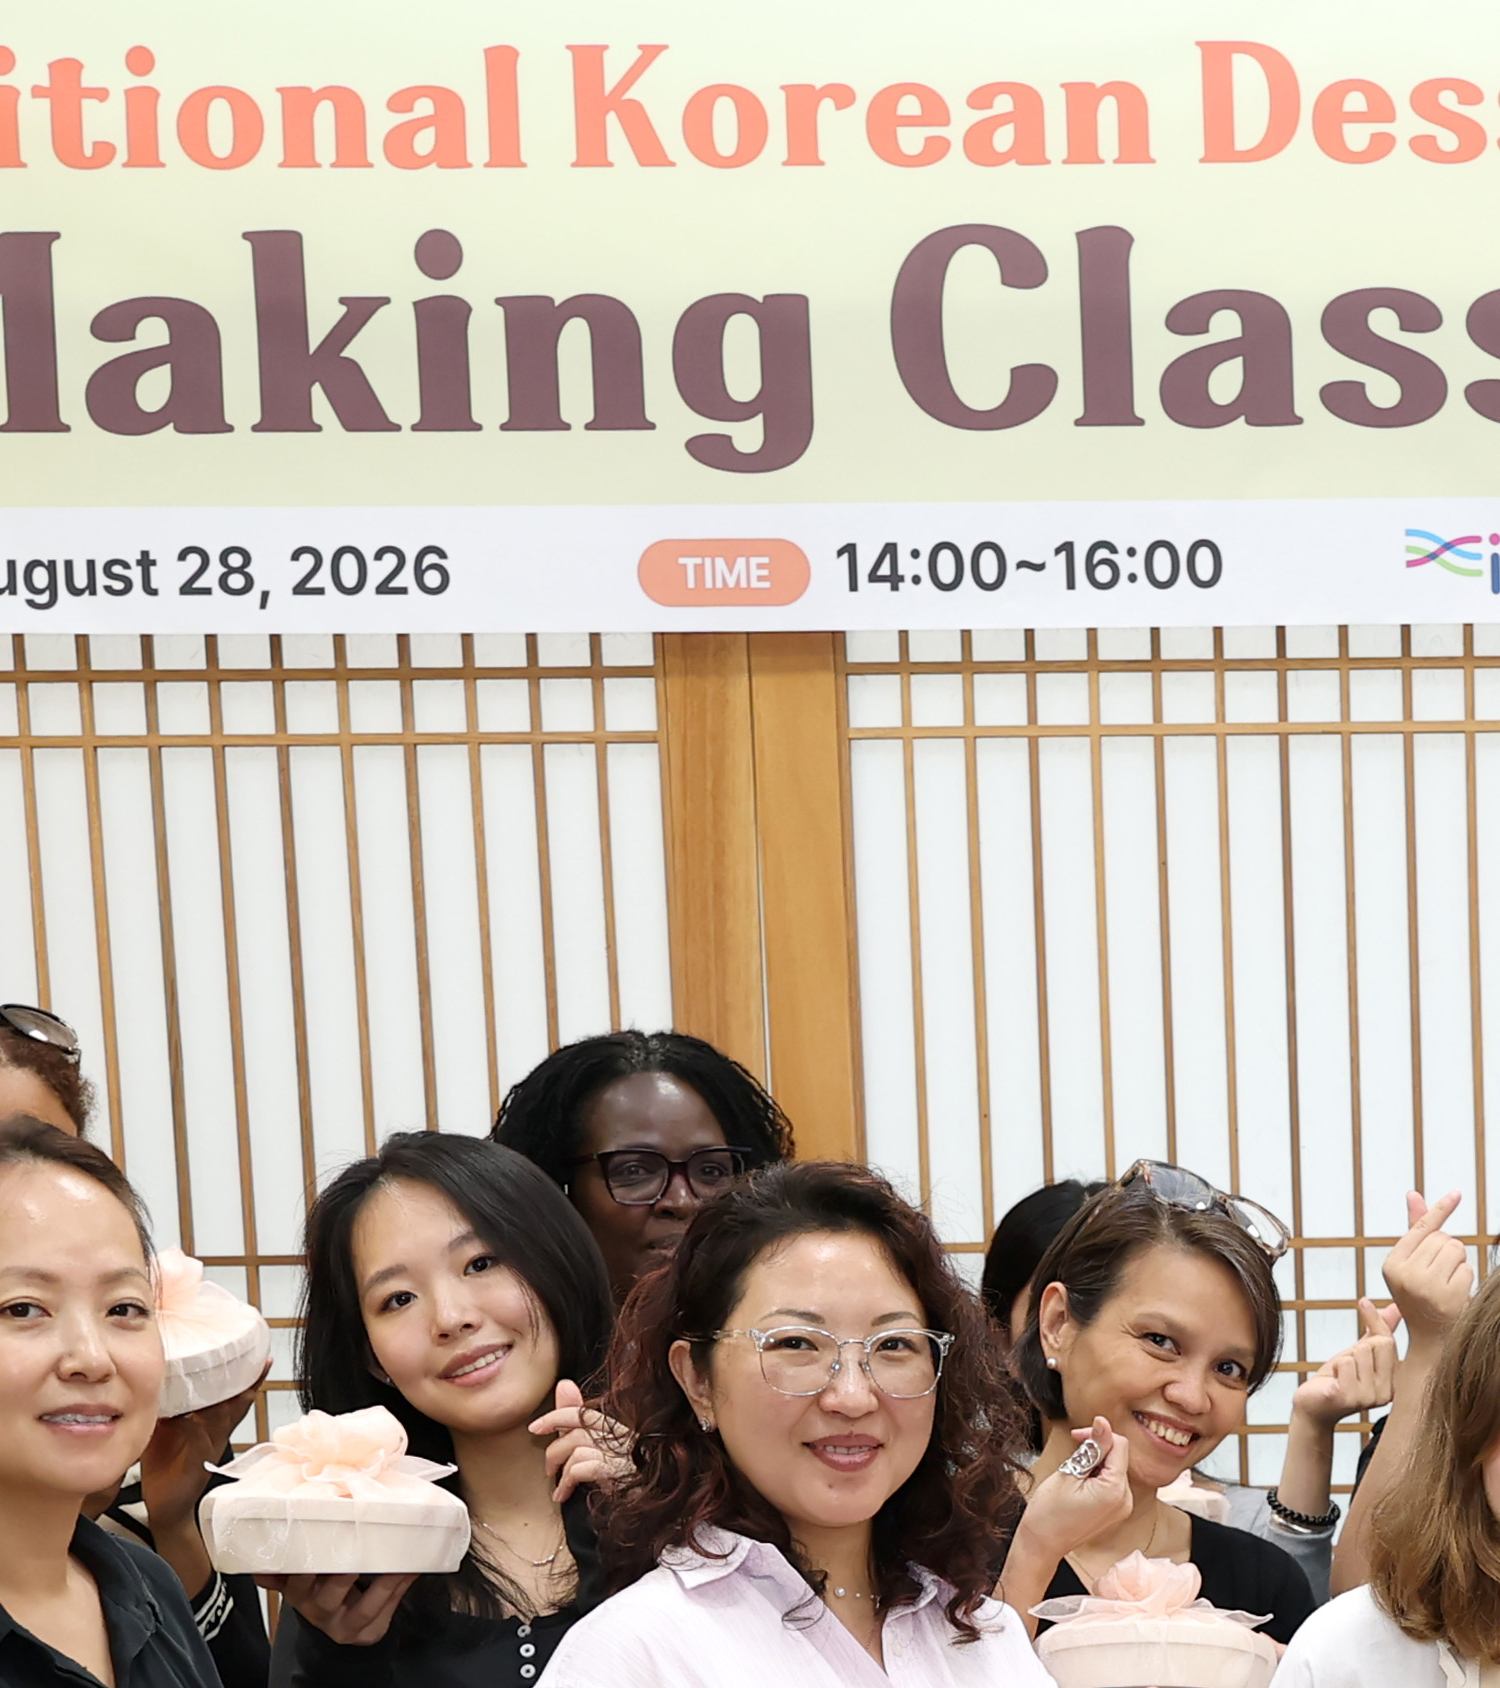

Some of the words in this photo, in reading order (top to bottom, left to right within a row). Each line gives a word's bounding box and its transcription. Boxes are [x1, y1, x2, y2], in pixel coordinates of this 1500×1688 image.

[567, 44, 1157, 171] Korean
[177, 545, 272, 612] 28,
[290, 545, 452, 598] 2026
[677, 556, 772, 589] TIME
[836, 539, 1225, 594] 14:00~16:00
